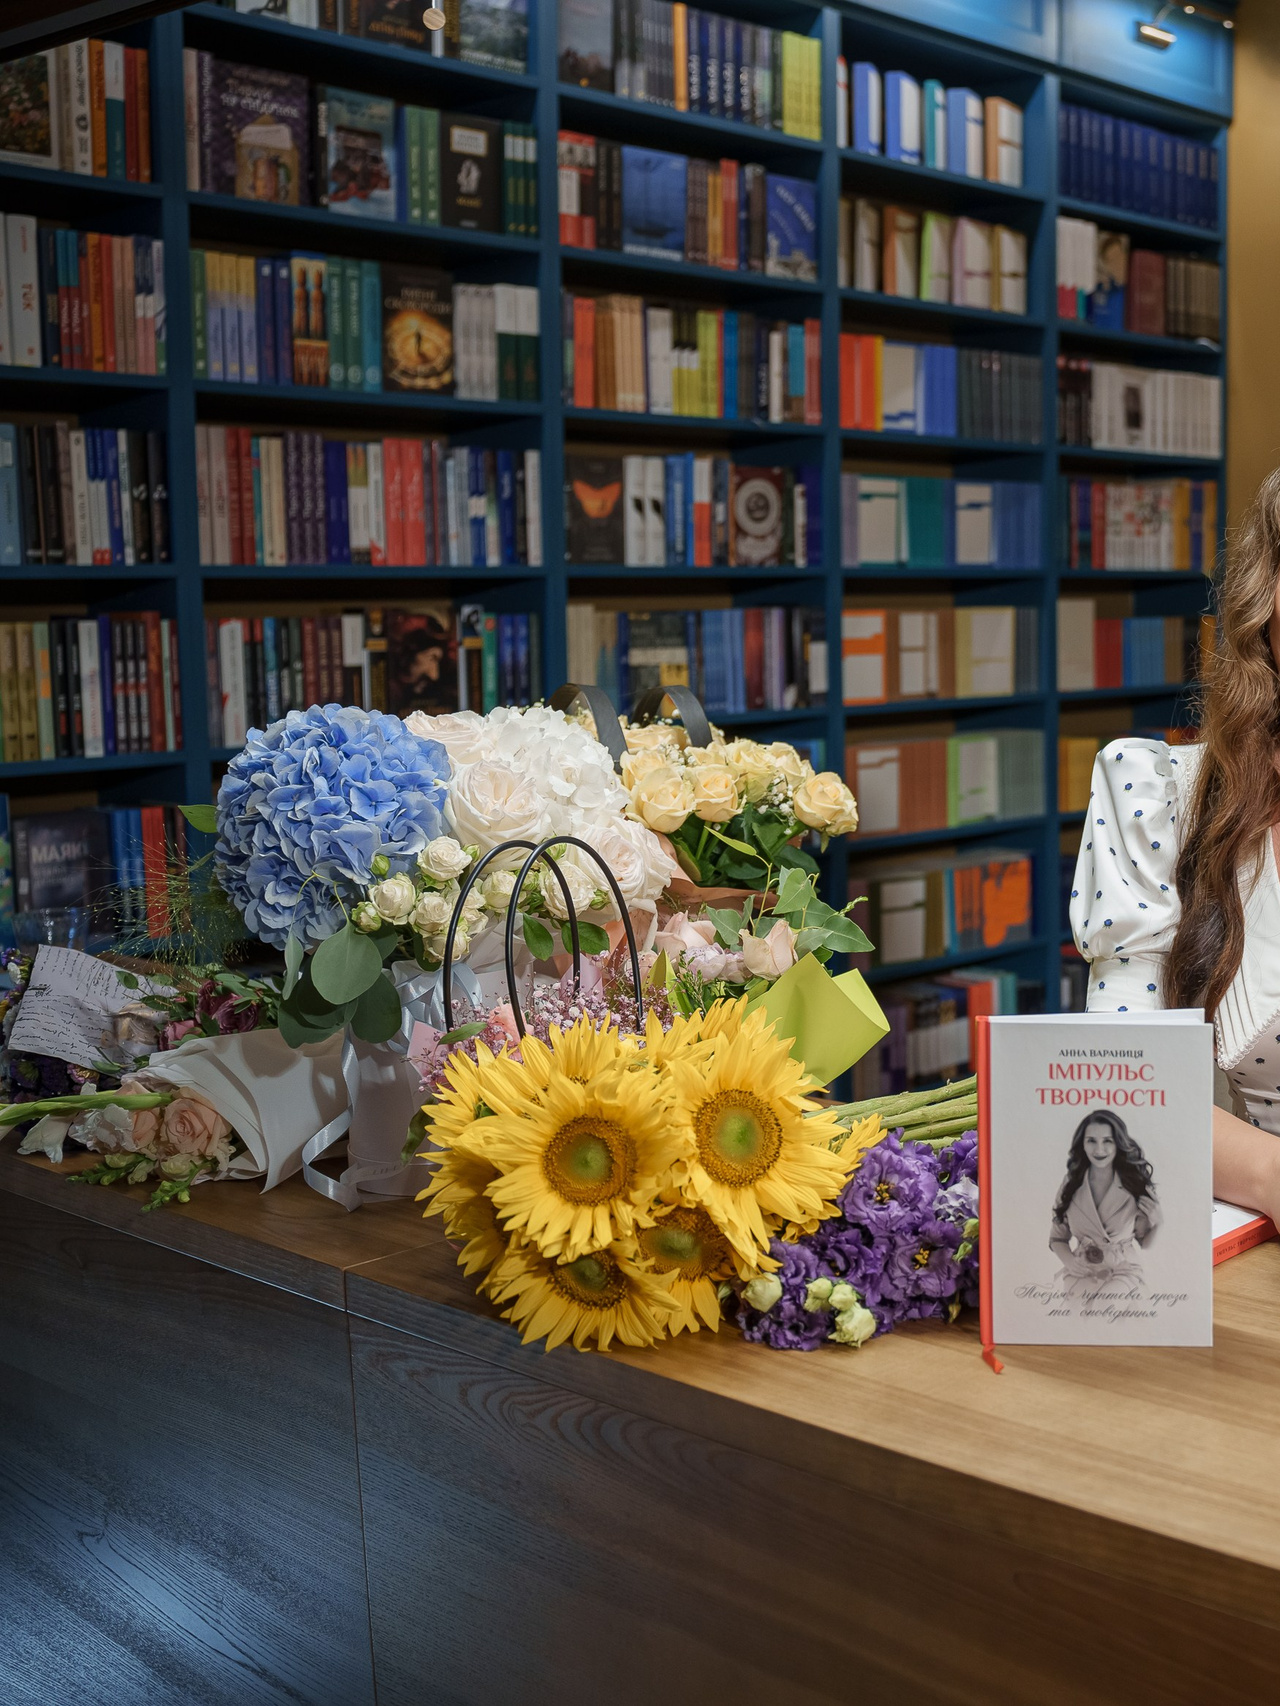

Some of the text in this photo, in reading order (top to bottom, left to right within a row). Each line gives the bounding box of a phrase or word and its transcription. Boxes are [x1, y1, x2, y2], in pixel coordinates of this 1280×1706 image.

[1058, 1049, 1144, 1059] АННА ВАРАНИЦЯ
[1048, 1063, 1155, 1082] ІМПУЛЬС
[1035, 1087, 1167, 1107] ТВОРЧОСТІ
[1148, 1291, 1188, 1307] проза
[1047, 1304, 1158, 1324] та оповідання
